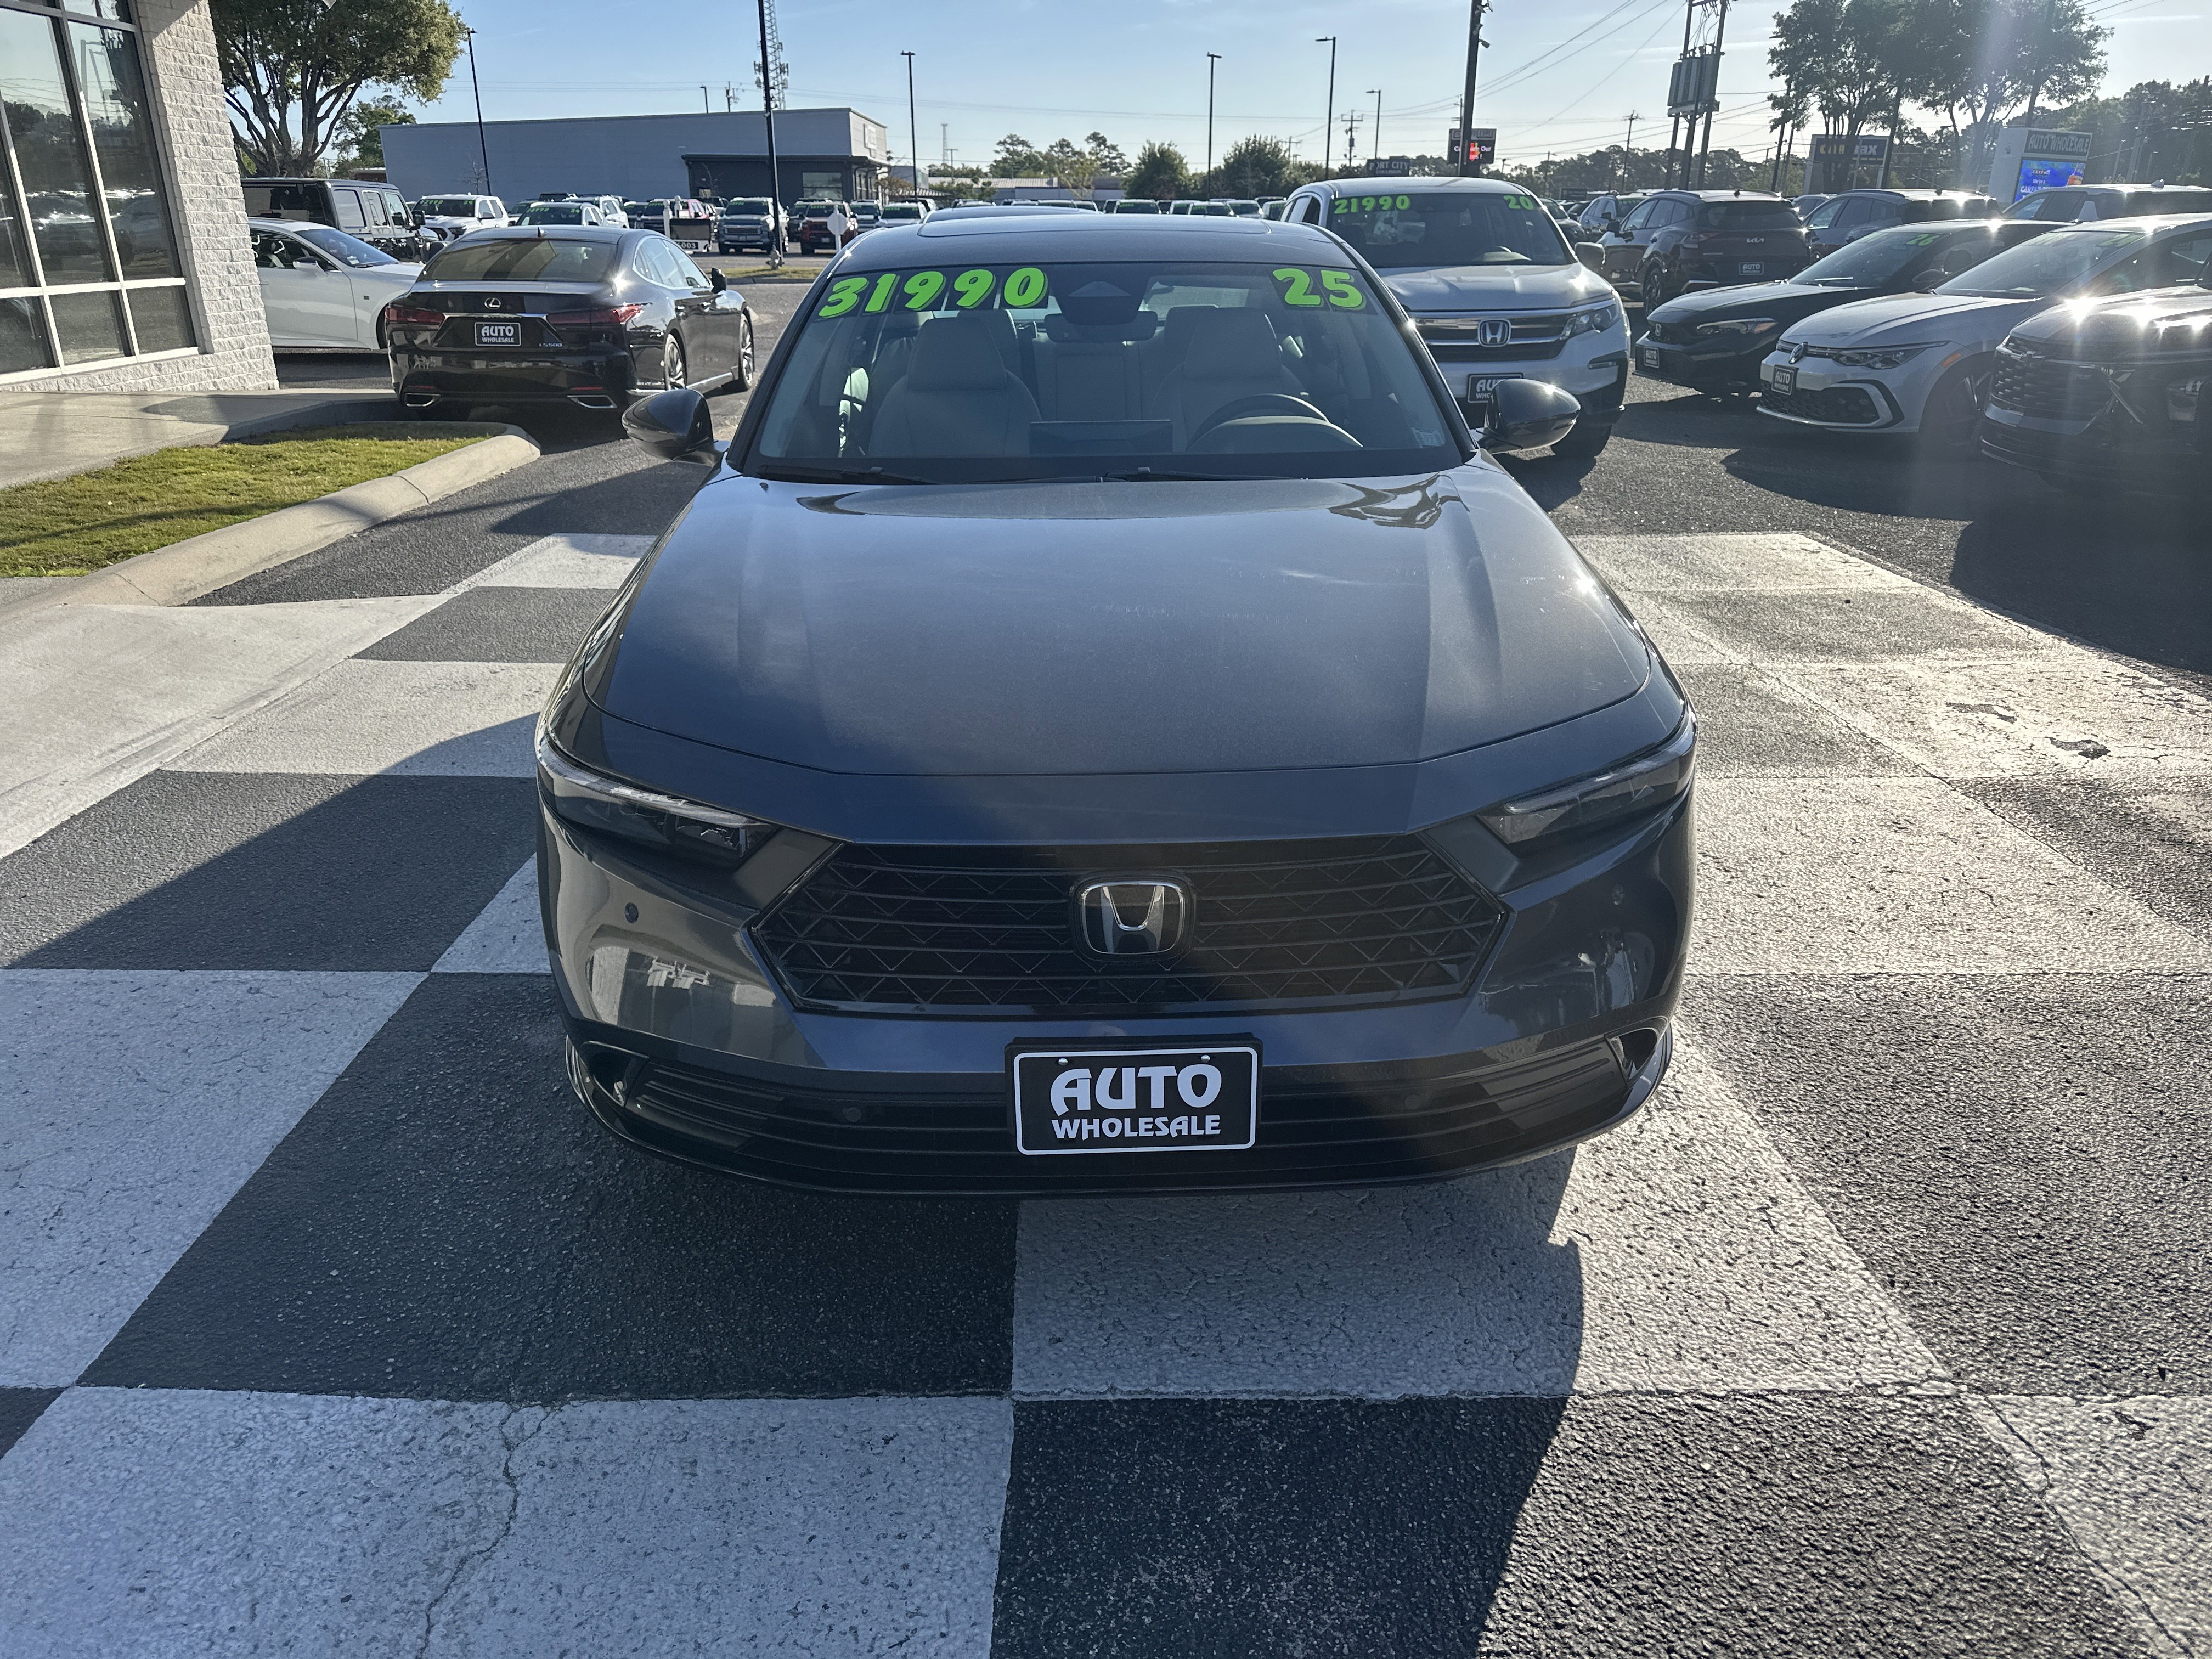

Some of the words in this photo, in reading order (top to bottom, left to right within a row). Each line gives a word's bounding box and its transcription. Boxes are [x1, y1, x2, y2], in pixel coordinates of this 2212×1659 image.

[2028, 134, 2049, 150] AUTO
[2050, 134, 2090, 153] WHOLESALE
[1392, 161, 1409, 170] CITY
[1334, 195, 1410, 214] 21990
[1504, 195, 1534, 210] 20
[1906, 234, 1940, 246] 26
[819, 267, 1048, 319] 31990
[1273, 268, 1367, 311] 25
[481, 326, 515, 337] AUTO
[1775, 371, 1791, 384] AUTO
[1050, 1064, 1222, 1116] AUTO
[1051, 1114, 1221, 1141] WHOLESALE
